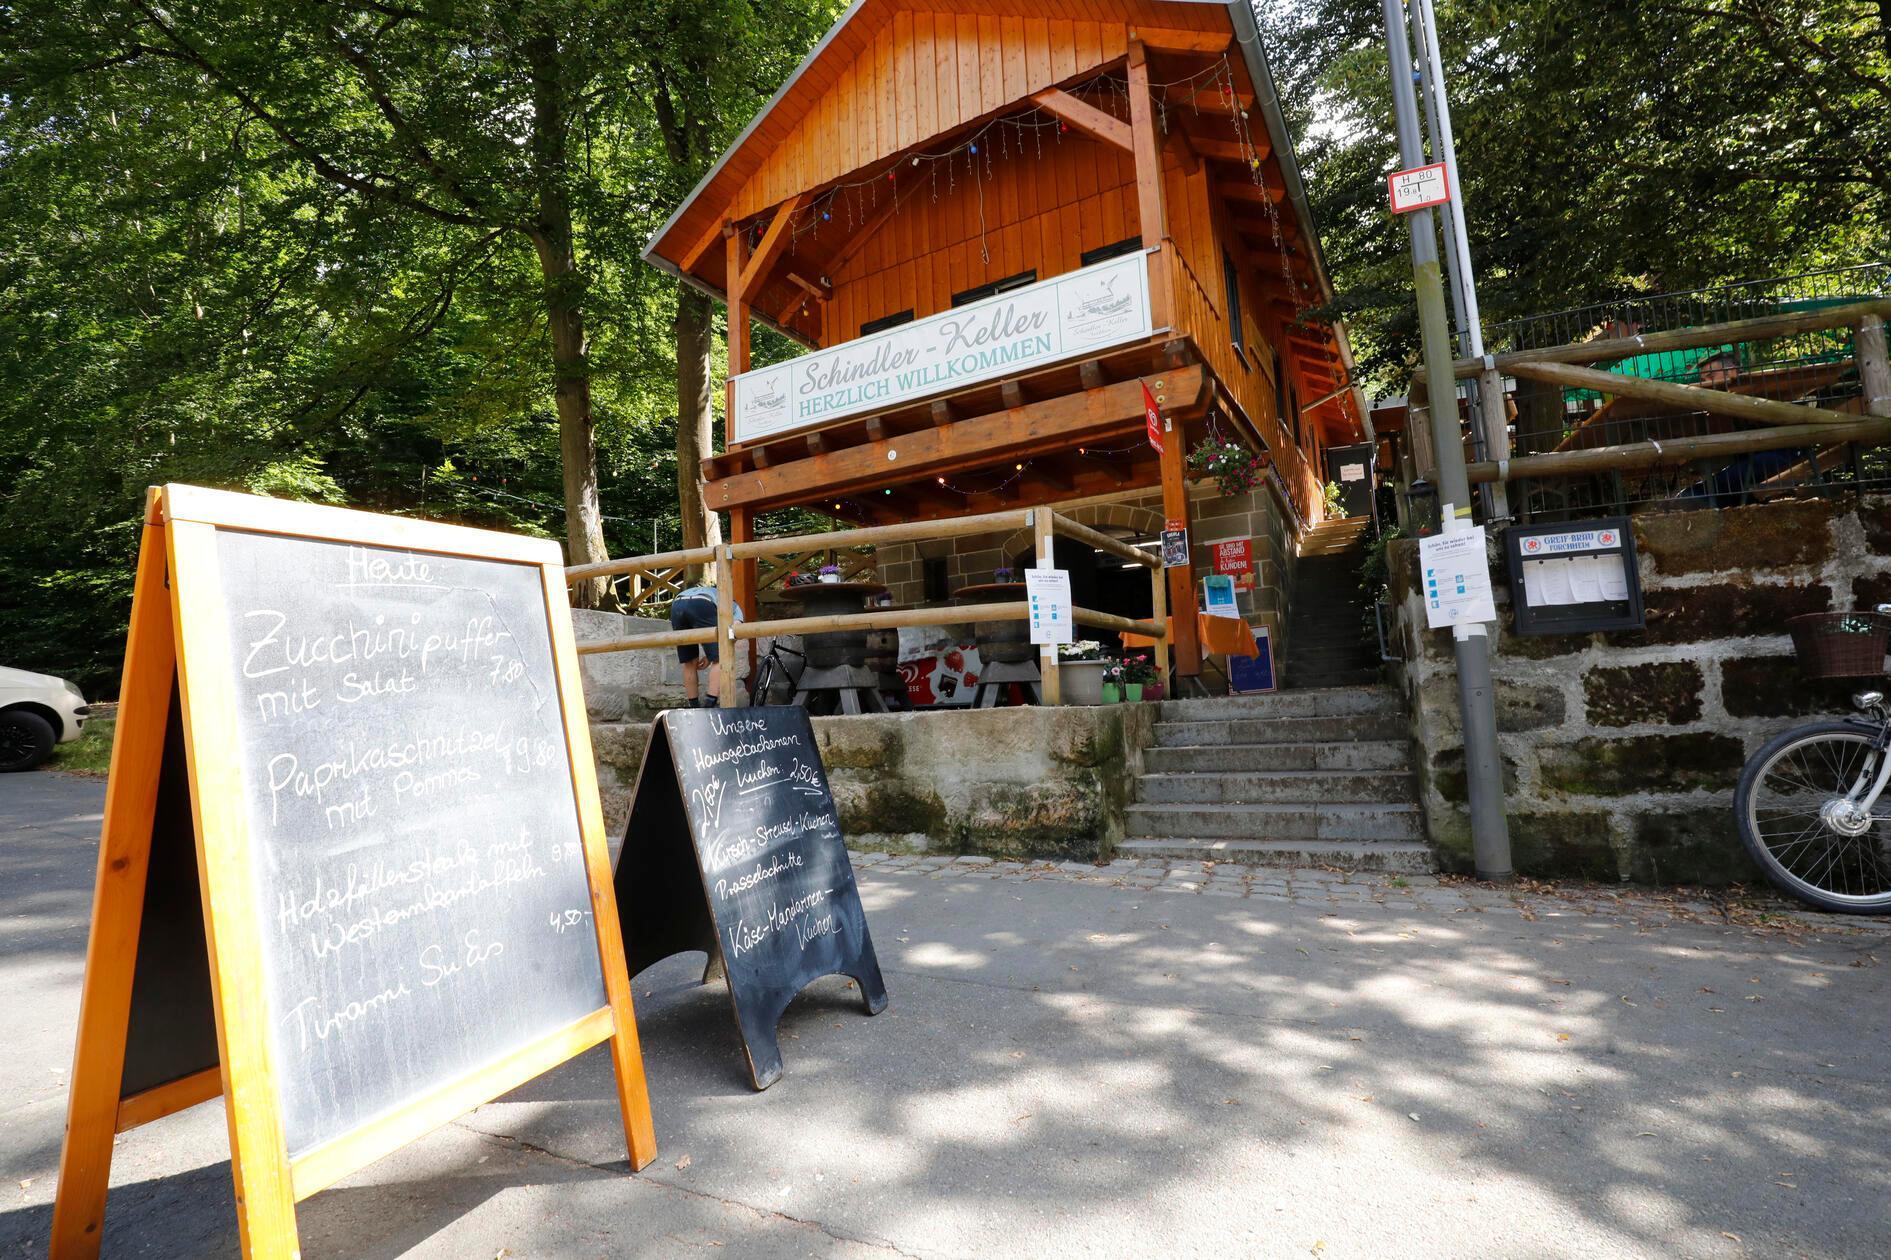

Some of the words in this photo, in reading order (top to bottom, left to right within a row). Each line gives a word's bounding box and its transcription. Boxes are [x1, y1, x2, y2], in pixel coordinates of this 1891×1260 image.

[1402, 175, 1410, 184] H
[1418, 170, 1432, 181] 80
[799, 340, 920, 395] Schindler
[939, 303, 1049, 355] Keller
[799, 377, 891, 417] HERZLICH
[896, 332, 1052, 391] WILLKOMMEN
[1219, 547, 1245, 557] ABSTAND
[1550, 542, 1590, 551] FORCHHEIM
[1220, 560, 1248, 571] KUNDEN!
[257, 678, 320, 723] mit
[336, 668, 416, 703] Salat
[709, 713, 767, 736] Unsere
[692, 735, 801, 772] Hausgebackenen
[325, 784, 378, 829] mit
[394, 765, 481, 804] Pommes
[487, 823, 533, 859] mit
[795, 913, 842, 951] Kuchen
